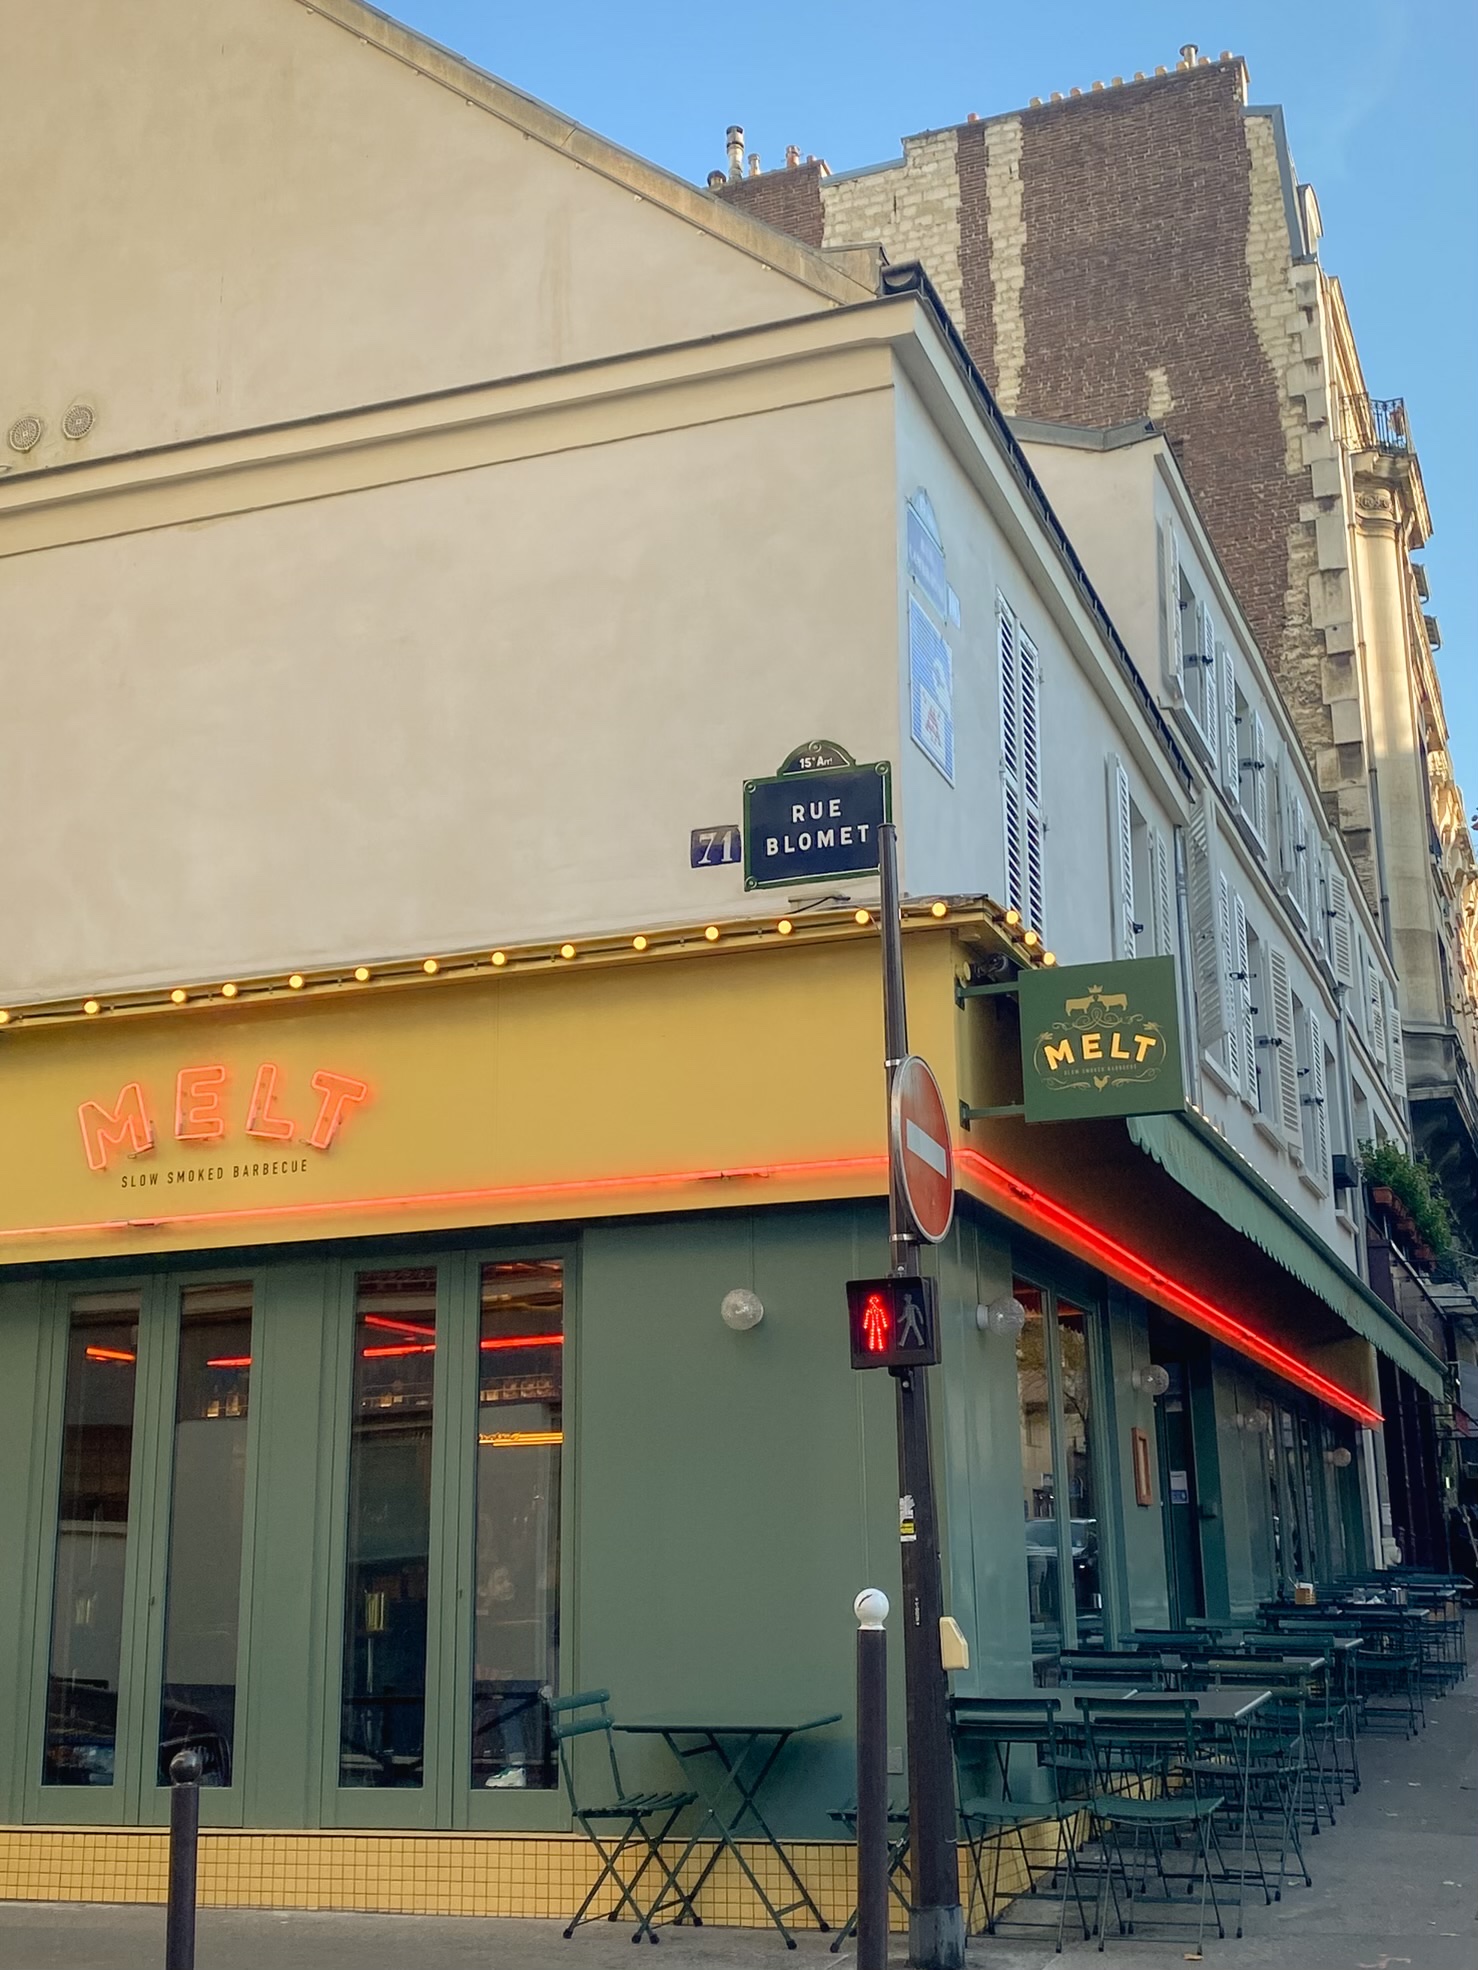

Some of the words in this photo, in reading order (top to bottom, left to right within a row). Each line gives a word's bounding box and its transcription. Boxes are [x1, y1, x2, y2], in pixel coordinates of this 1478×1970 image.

[792, 798, 842, 823] RUE
[698, 831, 735, 865] 71
[766, 824, 870, 857] BLOMET
[1043, 1032, 1157, 1071] MELT
[77, 1062, 369, 1171] MELT
[121, 1173, 159, 1188] SLOW
[167, 1167, 224, 1184] SMOKED
[233, 1159, 308, 1178] BARBECUE
